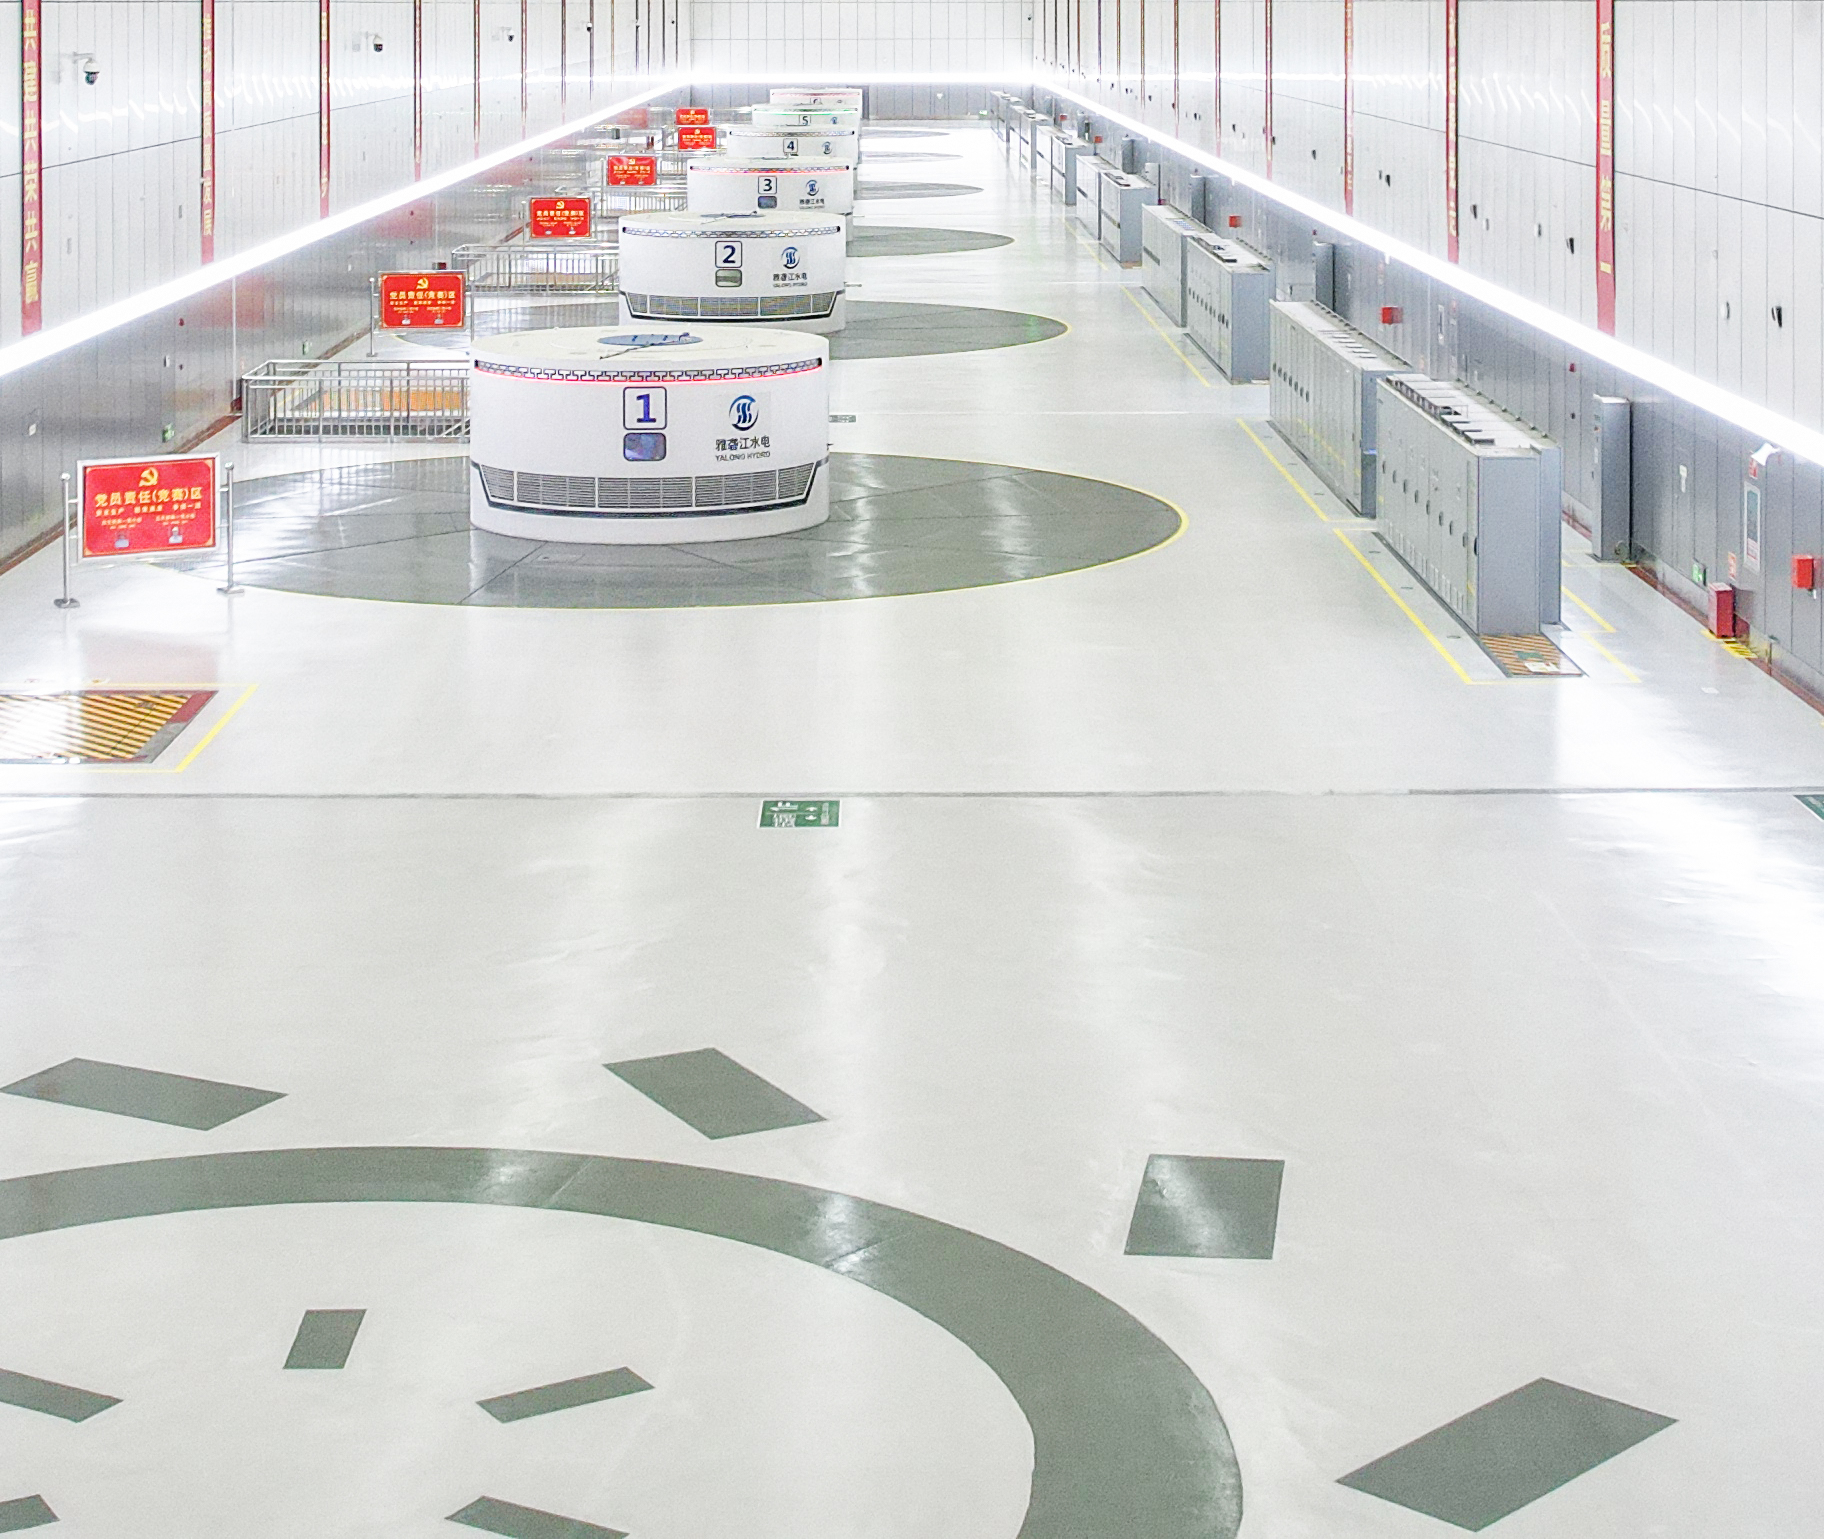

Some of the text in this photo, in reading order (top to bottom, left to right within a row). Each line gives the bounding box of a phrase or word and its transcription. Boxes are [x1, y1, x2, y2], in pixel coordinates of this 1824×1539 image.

[786, 140, 795, 151] 4
[1599, 19, 1613, 275] 质量第一
[763, 178, 772, 192] 3
[722, 244, 736, 264] 2
[636, 393, 657, 424] 1
[715, 435, 771, 451] 雅砻江水电
[95, 486, 203, 507] 党员责任(竞赛)区
